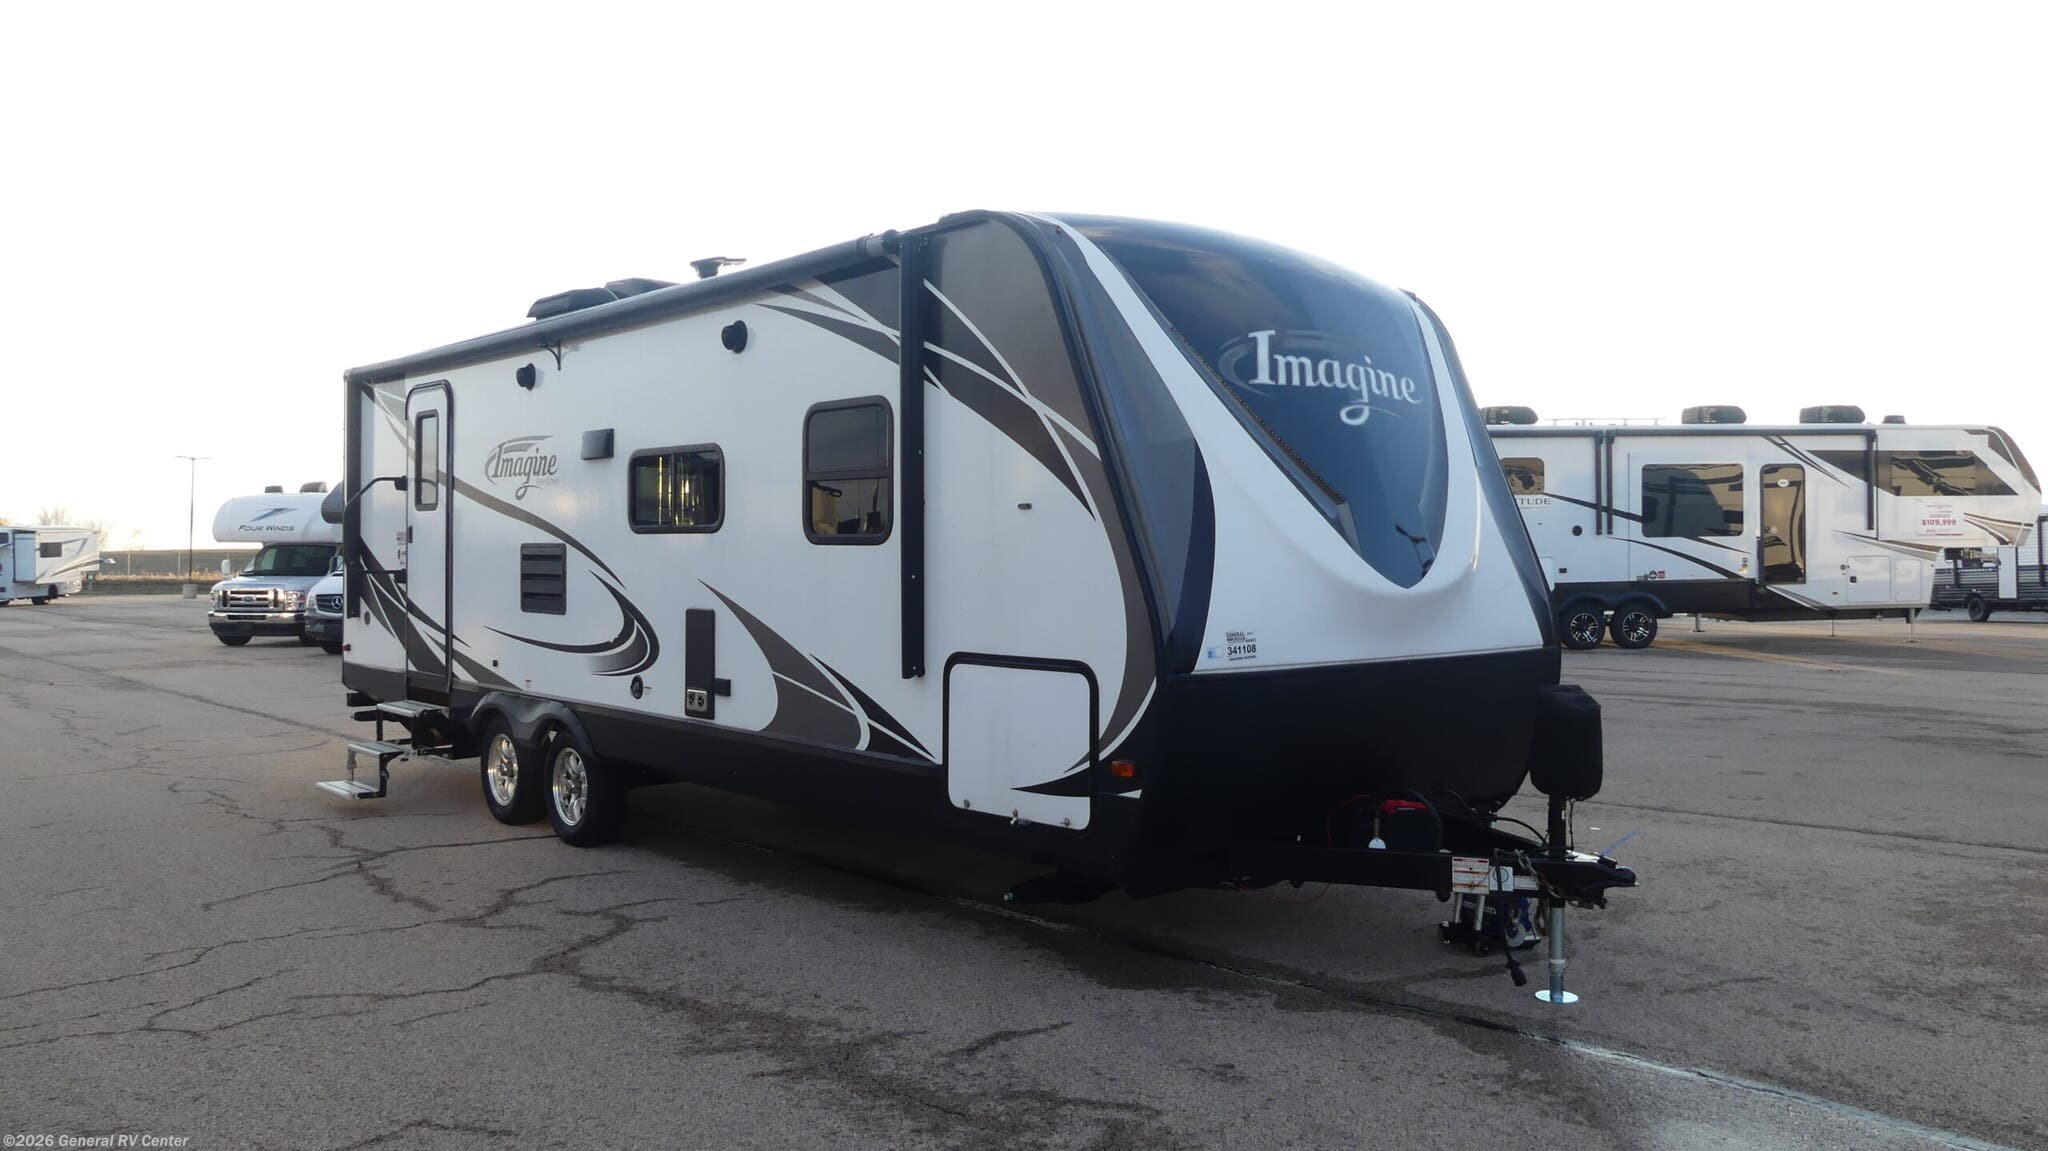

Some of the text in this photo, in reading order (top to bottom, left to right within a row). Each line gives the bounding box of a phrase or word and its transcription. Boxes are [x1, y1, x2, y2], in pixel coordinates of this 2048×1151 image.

[1247, 329, 1422, 426] Imagine
[491, 438, 559, 501] Imagine
[1227, 644, 1257, 655] 341108
